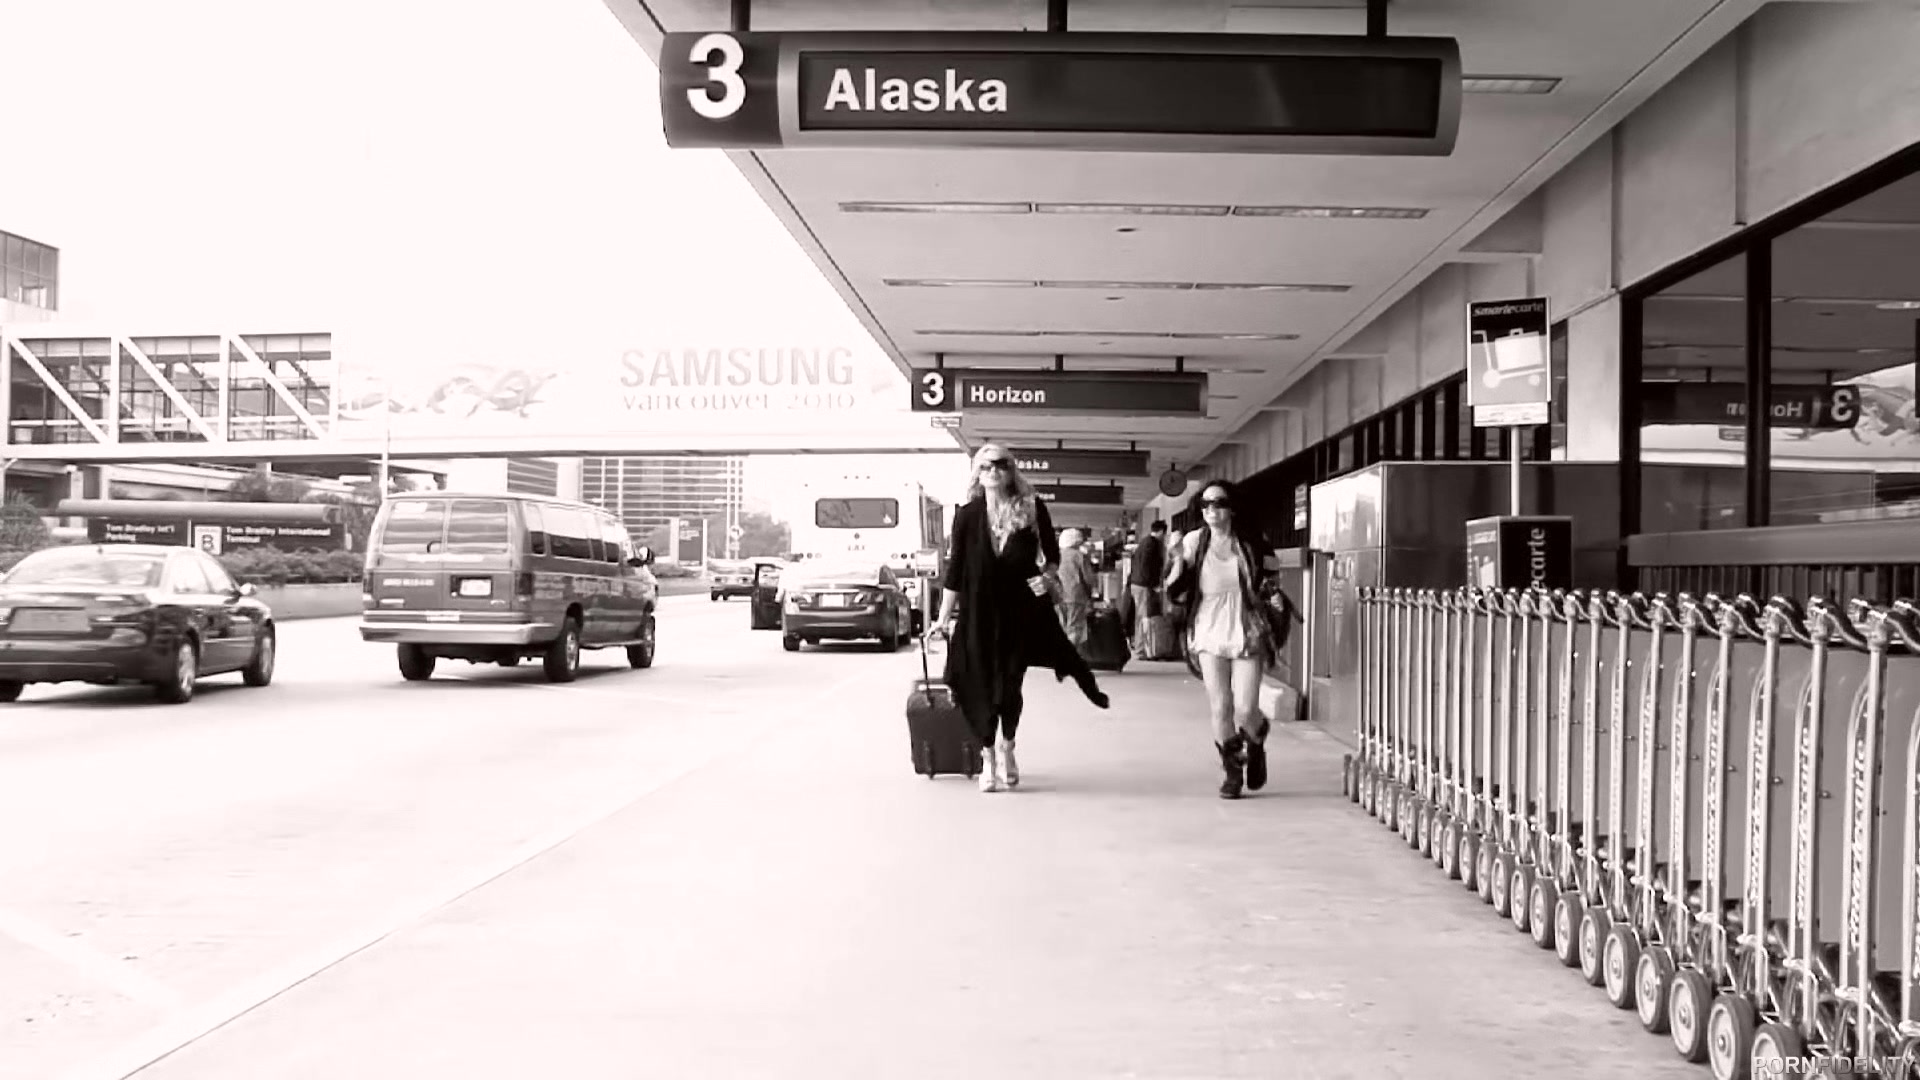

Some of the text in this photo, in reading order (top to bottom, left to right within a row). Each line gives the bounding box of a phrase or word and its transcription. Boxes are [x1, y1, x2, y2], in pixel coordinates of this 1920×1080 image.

[686, 33, 747, 119] 3
[824, 67, 1008, 112] Alaska
[620, 348, 854, 387] SAMSUNG
[922, 372, 945, 406] 3
[970, 384, 1046, 403] Horizon
[1014, 459, 1049, 469] laska
[125, 524, 155, 534] Bradley
[245, 526, 275, 536] Bradley
[278, 527, 331, 536] International
[1526, 527, 1546, 592] ecarte
